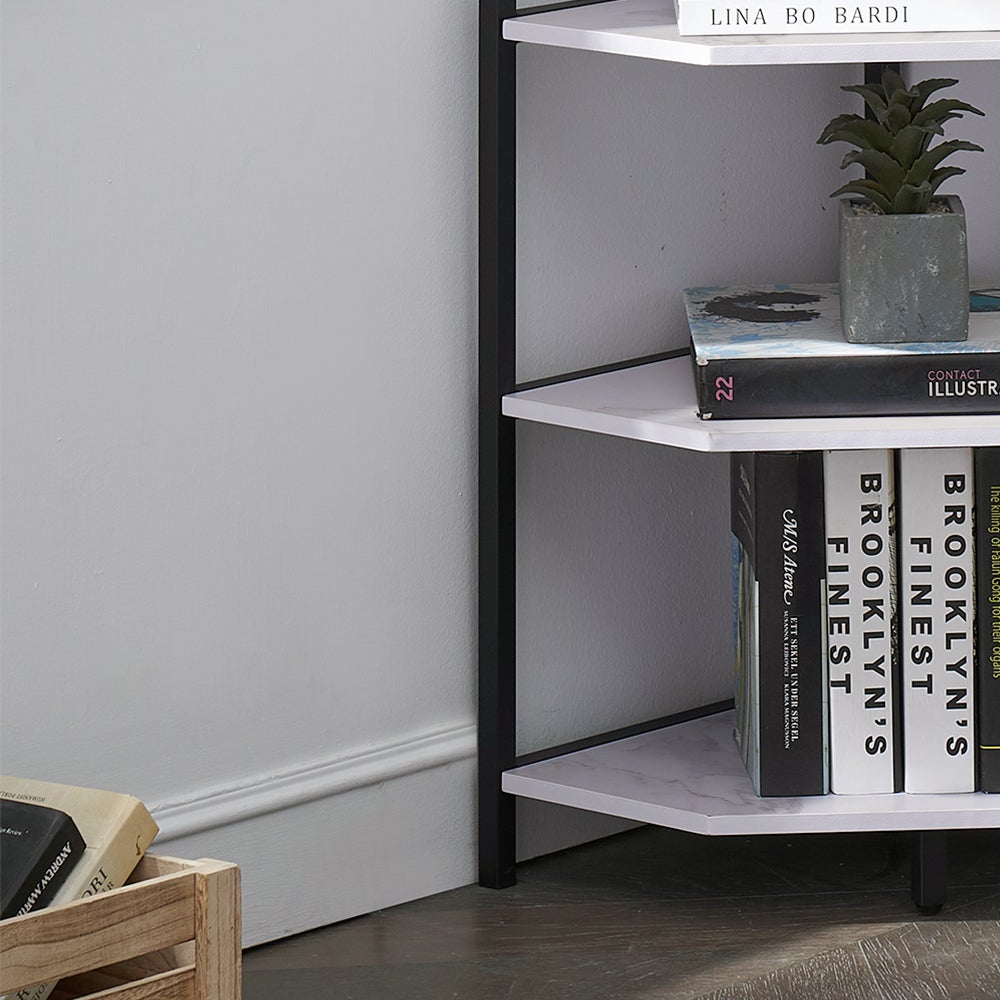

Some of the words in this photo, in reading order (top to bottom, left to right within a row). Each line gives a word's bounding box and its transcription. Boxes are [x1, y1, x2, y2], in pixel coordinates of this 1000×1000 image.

[711, 8, 767, 26] LINA
[786, 7, 815, 25] BO
[835, 6, 908, 24] BARDI
[715, 376, 734, 401] 22
[927, 369, 981, 381] CONTACT
[790, 617, 798, 636] ETT
[827, 537, 851, 694] FINEST
[860, 473, 887, 756] BROOKLYN'S
[909, 537, 933, 694] FINEST
[943, 474, 968, 757] BROOKLYN'S
[790, 638, 799, 670] SEKEL
[790, 673, 799, 708] UNDER
[790, 710, 799, 742] SEGEL
[40, 841, 72, 890] ANDREW
